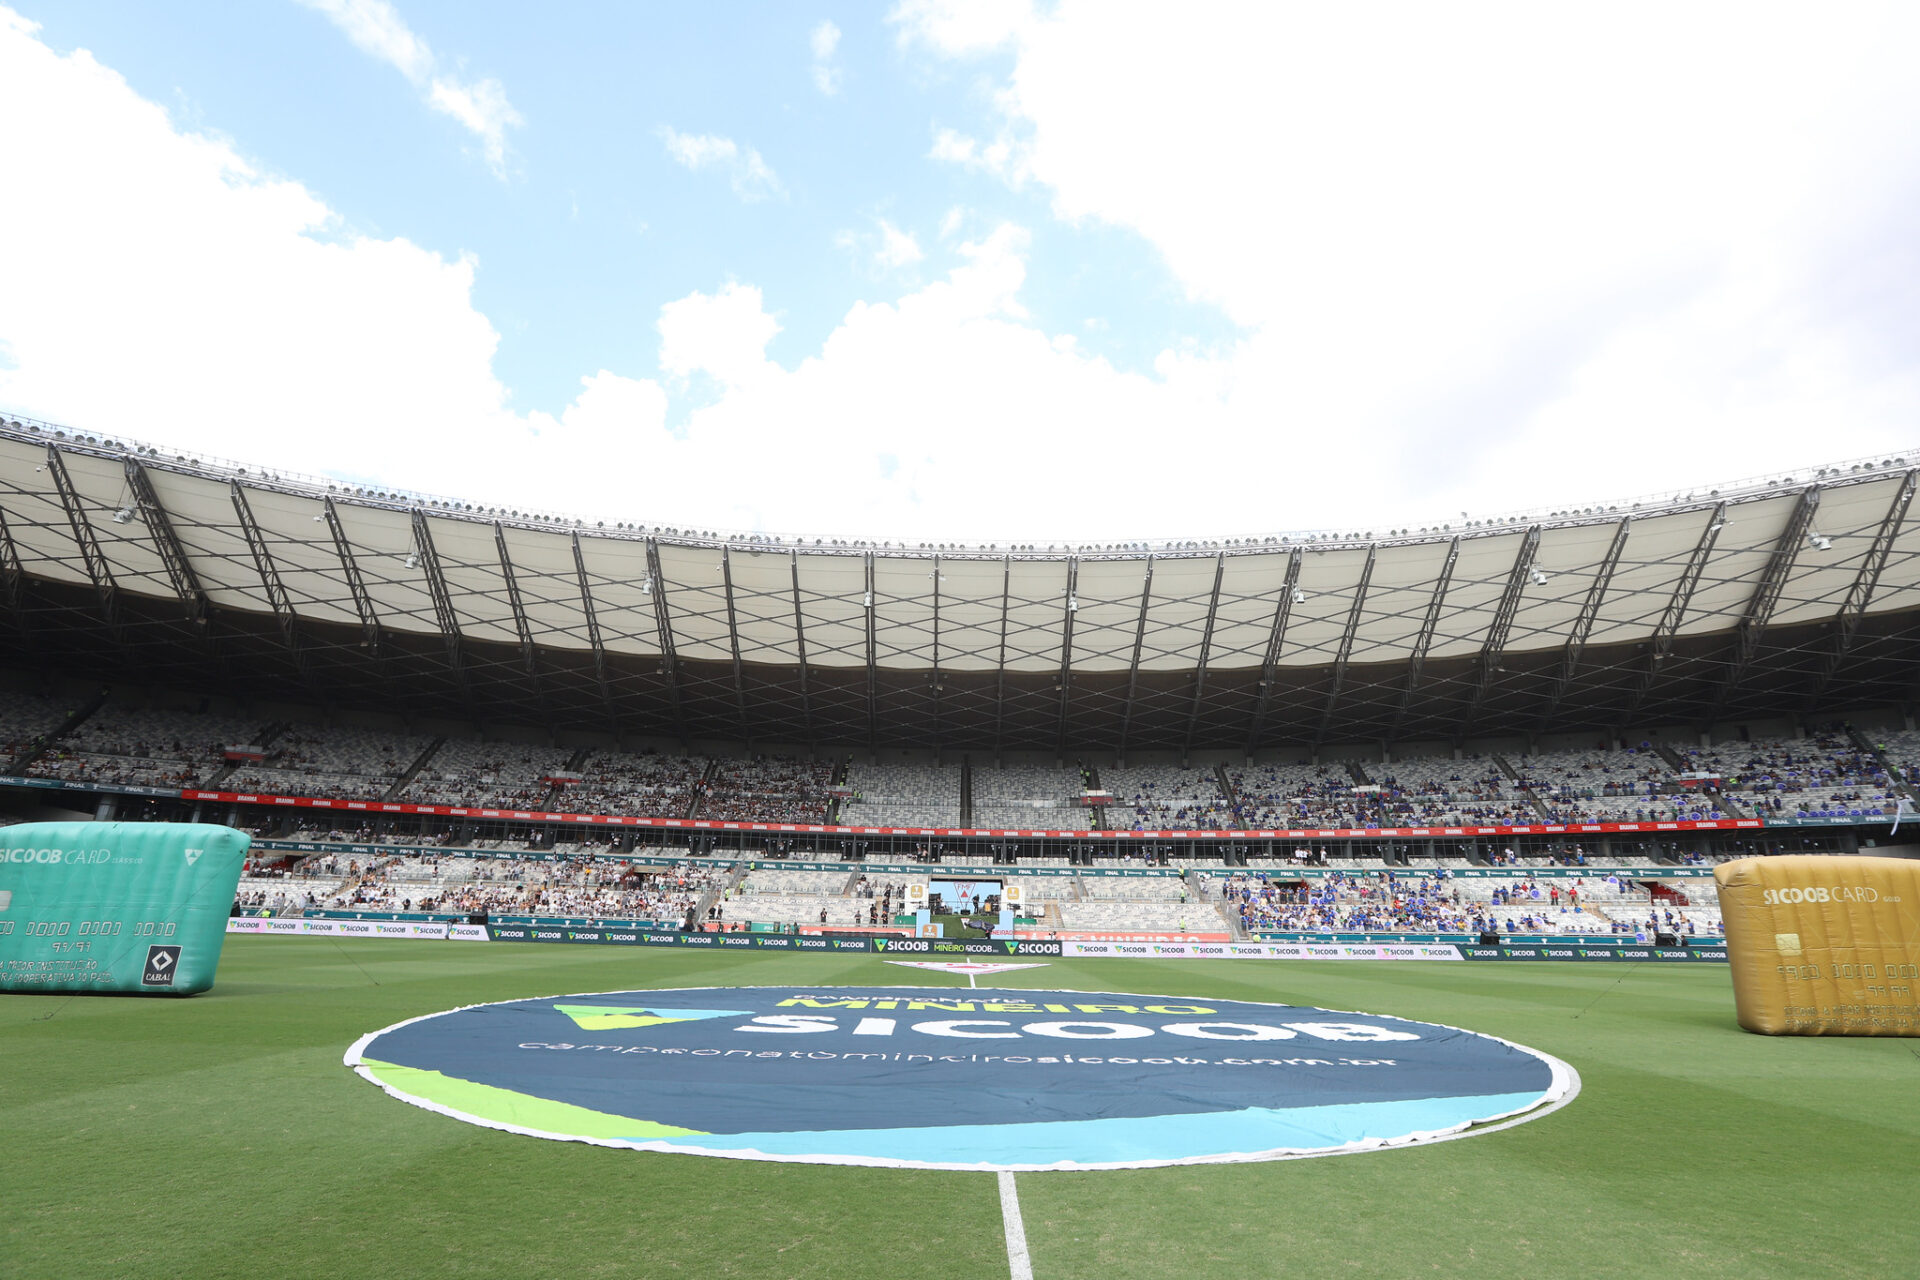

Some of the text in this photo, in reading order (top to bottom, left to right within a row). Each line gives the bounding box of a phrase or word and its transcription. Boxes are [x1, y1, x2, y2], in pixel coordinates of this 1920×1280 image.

[65, 848, 110, 864] CARD
[1763, 887, 1830, 904] SICOOB
[1831, 886, 1878, 903] CARD
[688, 936, 712, 944] SICOOB
[726, 937, 749, 945] SICOOB
[888, 942, 929, 951] SICOOB
[934, 944, 965, 952] MINEIRO
[1018, 944, 1060, 954] SICOOB
[775, 999, 1218, 1015] MINEIRO
[733, 1015, 1421, 1041] SICOOB
